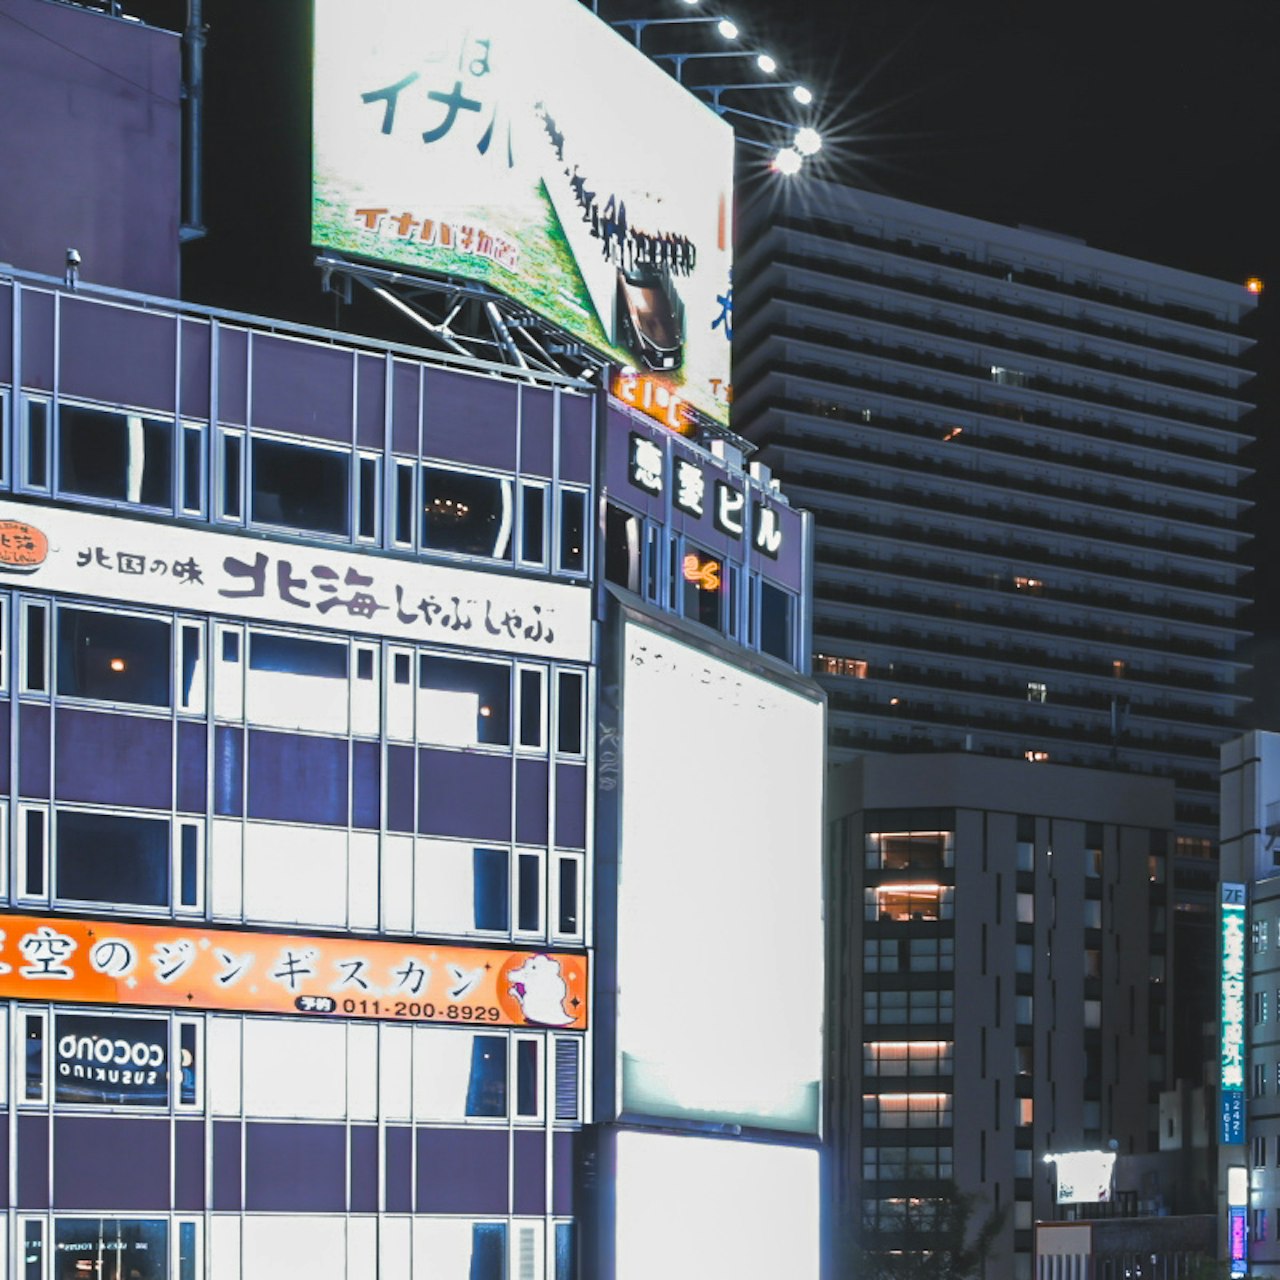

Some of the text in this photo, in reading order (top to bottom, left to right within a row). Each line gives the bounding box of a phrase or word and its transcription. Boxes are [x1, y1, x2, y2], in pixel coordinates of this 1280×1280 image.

[77, 546, 205, 586] 北国の味
[1225, 889, 1243, 902] 7F
[343, 998, 501, 1021] 011-200-8929
